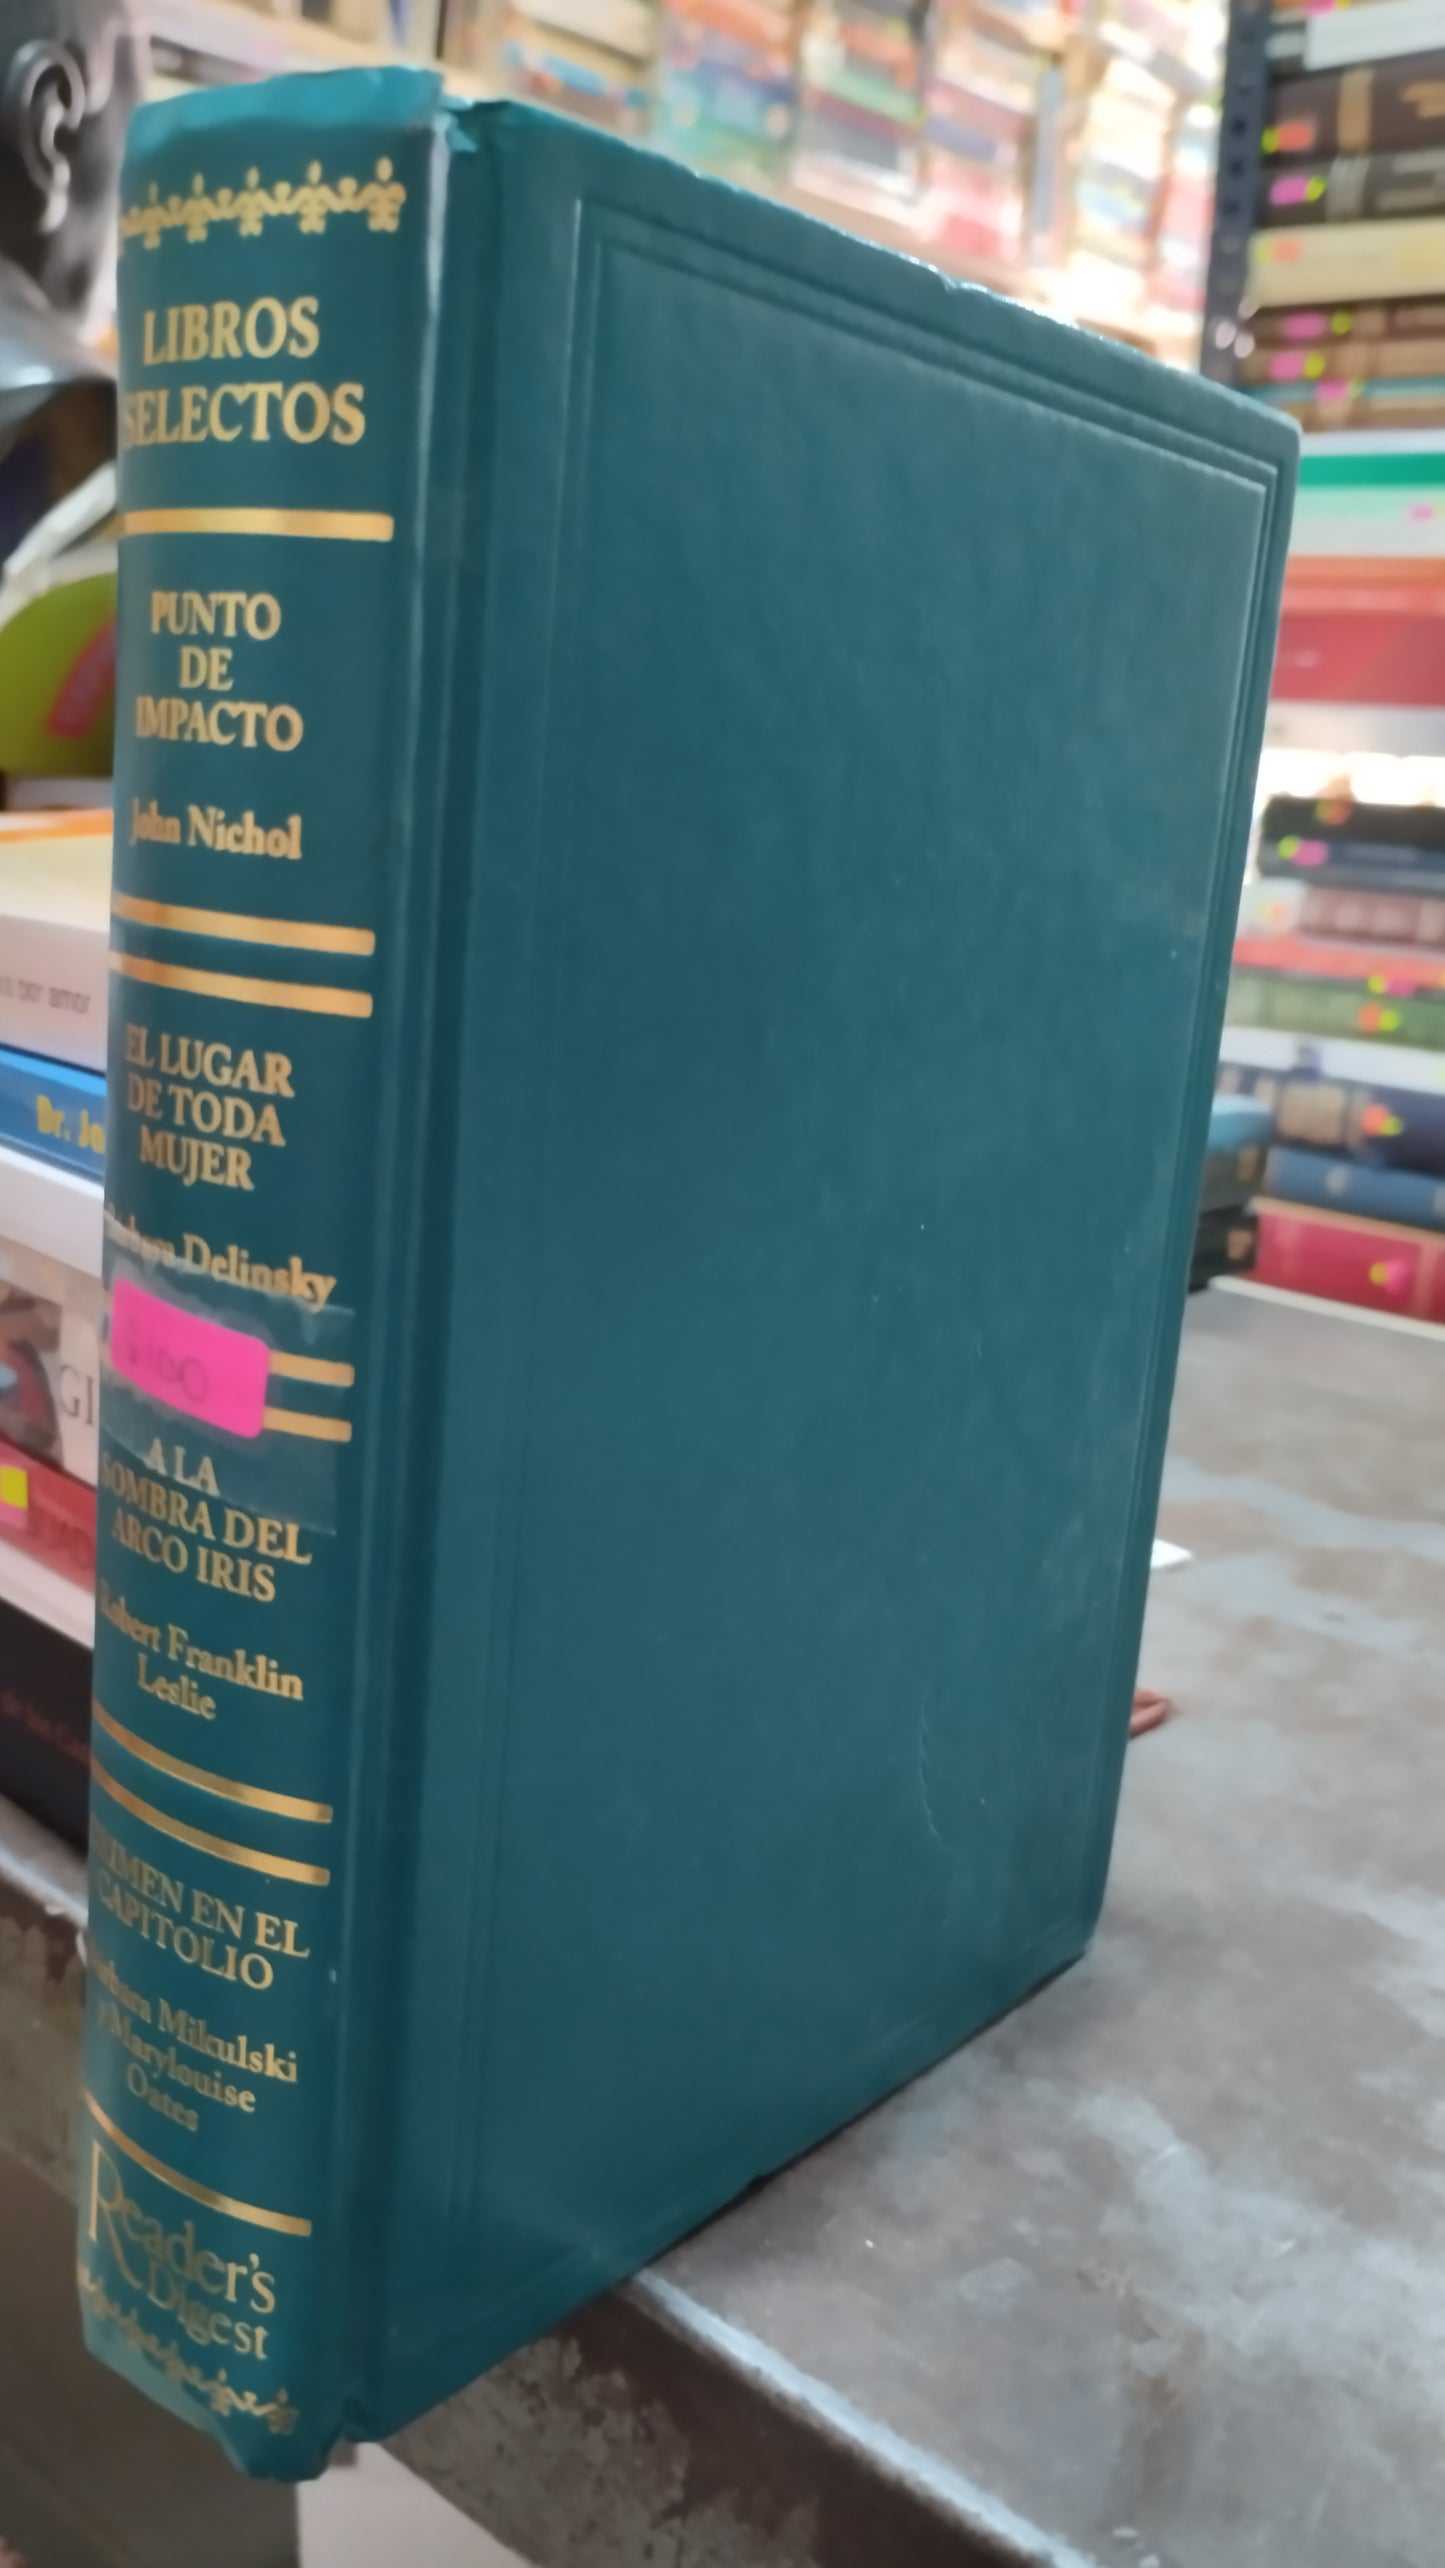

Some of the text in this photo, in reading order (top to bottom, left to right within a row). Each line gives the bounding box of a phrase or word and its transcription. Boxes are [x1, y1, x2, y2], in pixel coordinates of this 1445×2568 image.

[143, 296, 320, 366] LIBROS
[120, 381, 366, 449] SELECTOS
[151, 590, 282, 641] PUNTO
[179, 645, 234, 692] DE
[135, 695, 304, 752] IMPACTO
[129, 797, 303, 860] John Nichol
[125, 1022, 296, 1098] EL LUGAR
[36, 1094, 71, 1142] Dr.
[127, 1071, 286, 1147] DE TODA
[140, 1124, 255, 1191] MUJER
[183, 1232, 338, 1314] Delinsky
[145, 1436, 220, 1497] A LA
[112, 1506, 189, 1573] ARCO
[196, 1545, 276, 1603] IRIS
[223, 1506, 313, 1566] DEL
[137, 1652, 217, 1721] Leslie
[168, 1623, 304, 1702] Franklin
[99, 1867, 275, 1990] CAPITOLIO
[192, 1888, 246, 1939] EN
[255, 1911, 311, 1958] EL
[108, 2001, 257, 2123] Marylouise
[158, 1997, 299, 2083] Mikulski
[126, 2061, 199, 2132] Oates
[88, 2138, 277, 2314] Reader's
[147, 2260, 269, 2361] Digest
